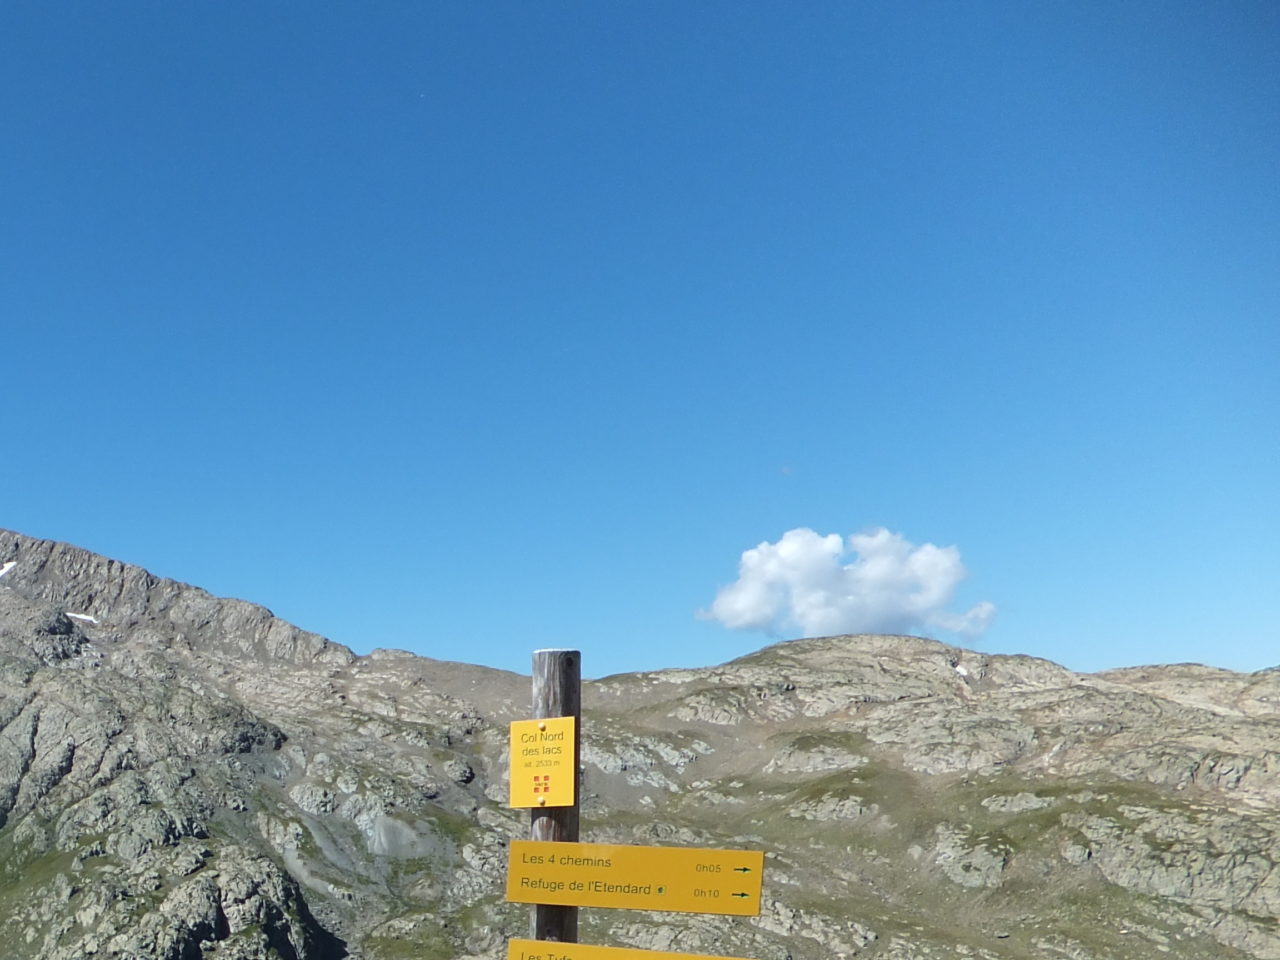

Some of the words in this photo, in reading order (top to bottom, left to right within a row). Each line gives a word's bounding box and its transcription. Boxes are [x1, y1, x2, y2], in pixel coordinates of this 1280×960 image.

[521, 733, 537, 743] Col
[540, 731, 564, 741] Nord
[522, 747, 539, 756] des
[542, 746, 562, 755] lacs
[522, 853, 544, 864] Les
[548, 854, 555, 864] 4
[560, 855, 612, 868] chemins
[696, 864, 721, 873] 0h05
[521, 877, 565, 892] Refuge
[569, 880, 584, 891] de
[588, 881, 651, 895] l'Etendard
[694, 888, 720, 898] 0h10
